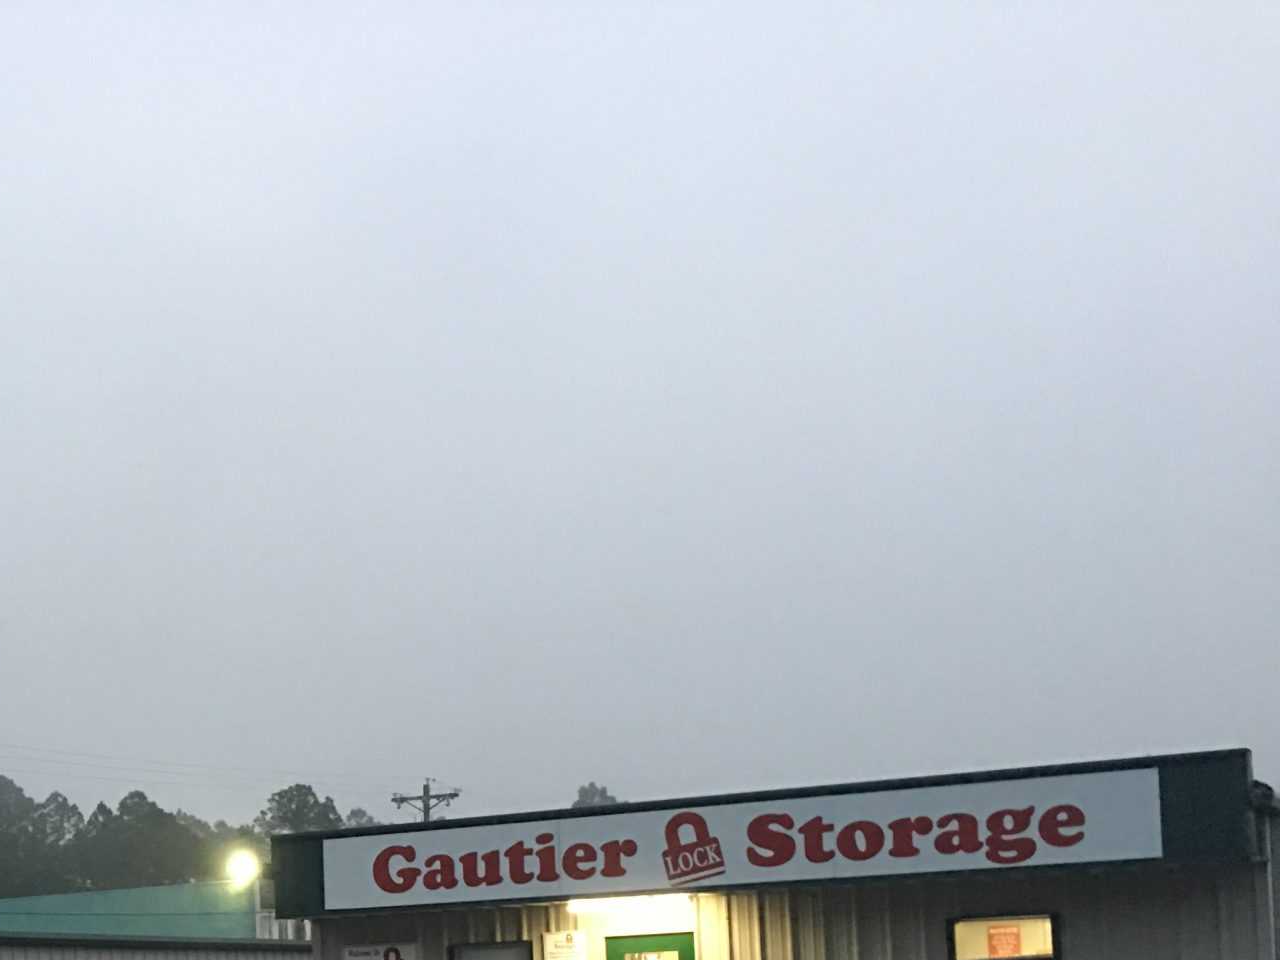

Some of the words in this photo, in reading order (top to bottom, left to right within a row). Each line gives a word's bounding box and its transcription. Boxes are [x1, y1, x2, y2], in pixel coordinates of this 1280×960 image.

[372, 832, 638, 894] Gautier
[665, 843, 722, 875] LOCK
[746, 804, 1086, 868] Storage
